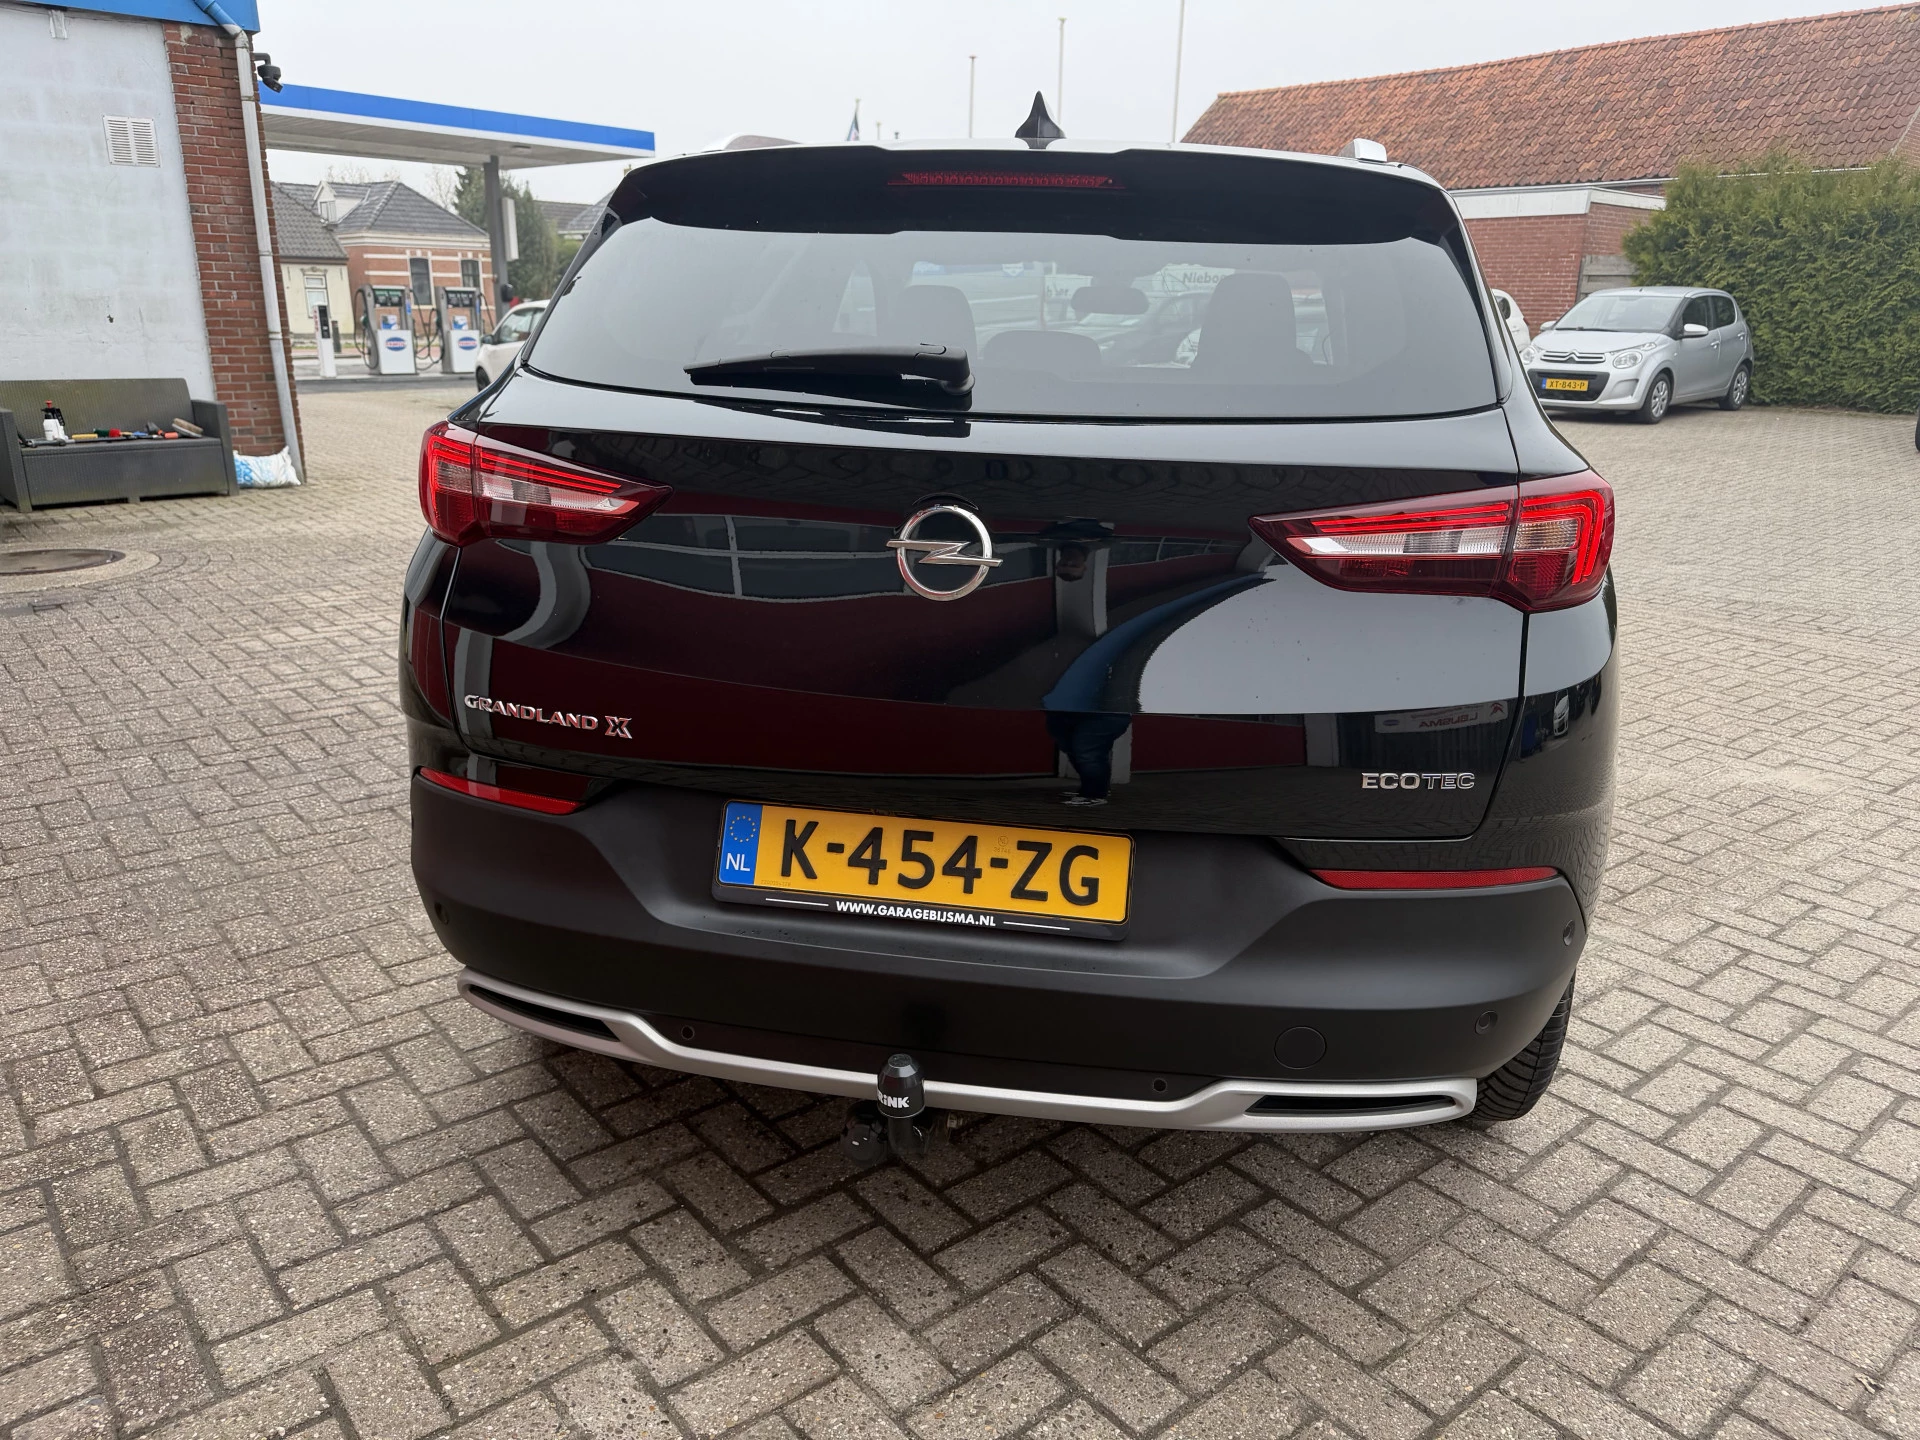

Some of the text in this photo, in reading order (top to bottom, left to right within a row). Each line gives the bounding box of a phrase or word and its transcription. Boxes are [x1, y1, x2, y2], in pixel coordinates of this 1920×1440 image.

[464, 694, 632, 739] GRANDLAND X
[1361, 772, 1475, 790] ECOTEC
[725, 852, 751, 871] NL
[780, 817, 1101, 906] K-454-ZG
[835, 900, 997, 927] WWW.GARAGEBIJSMA.NL
